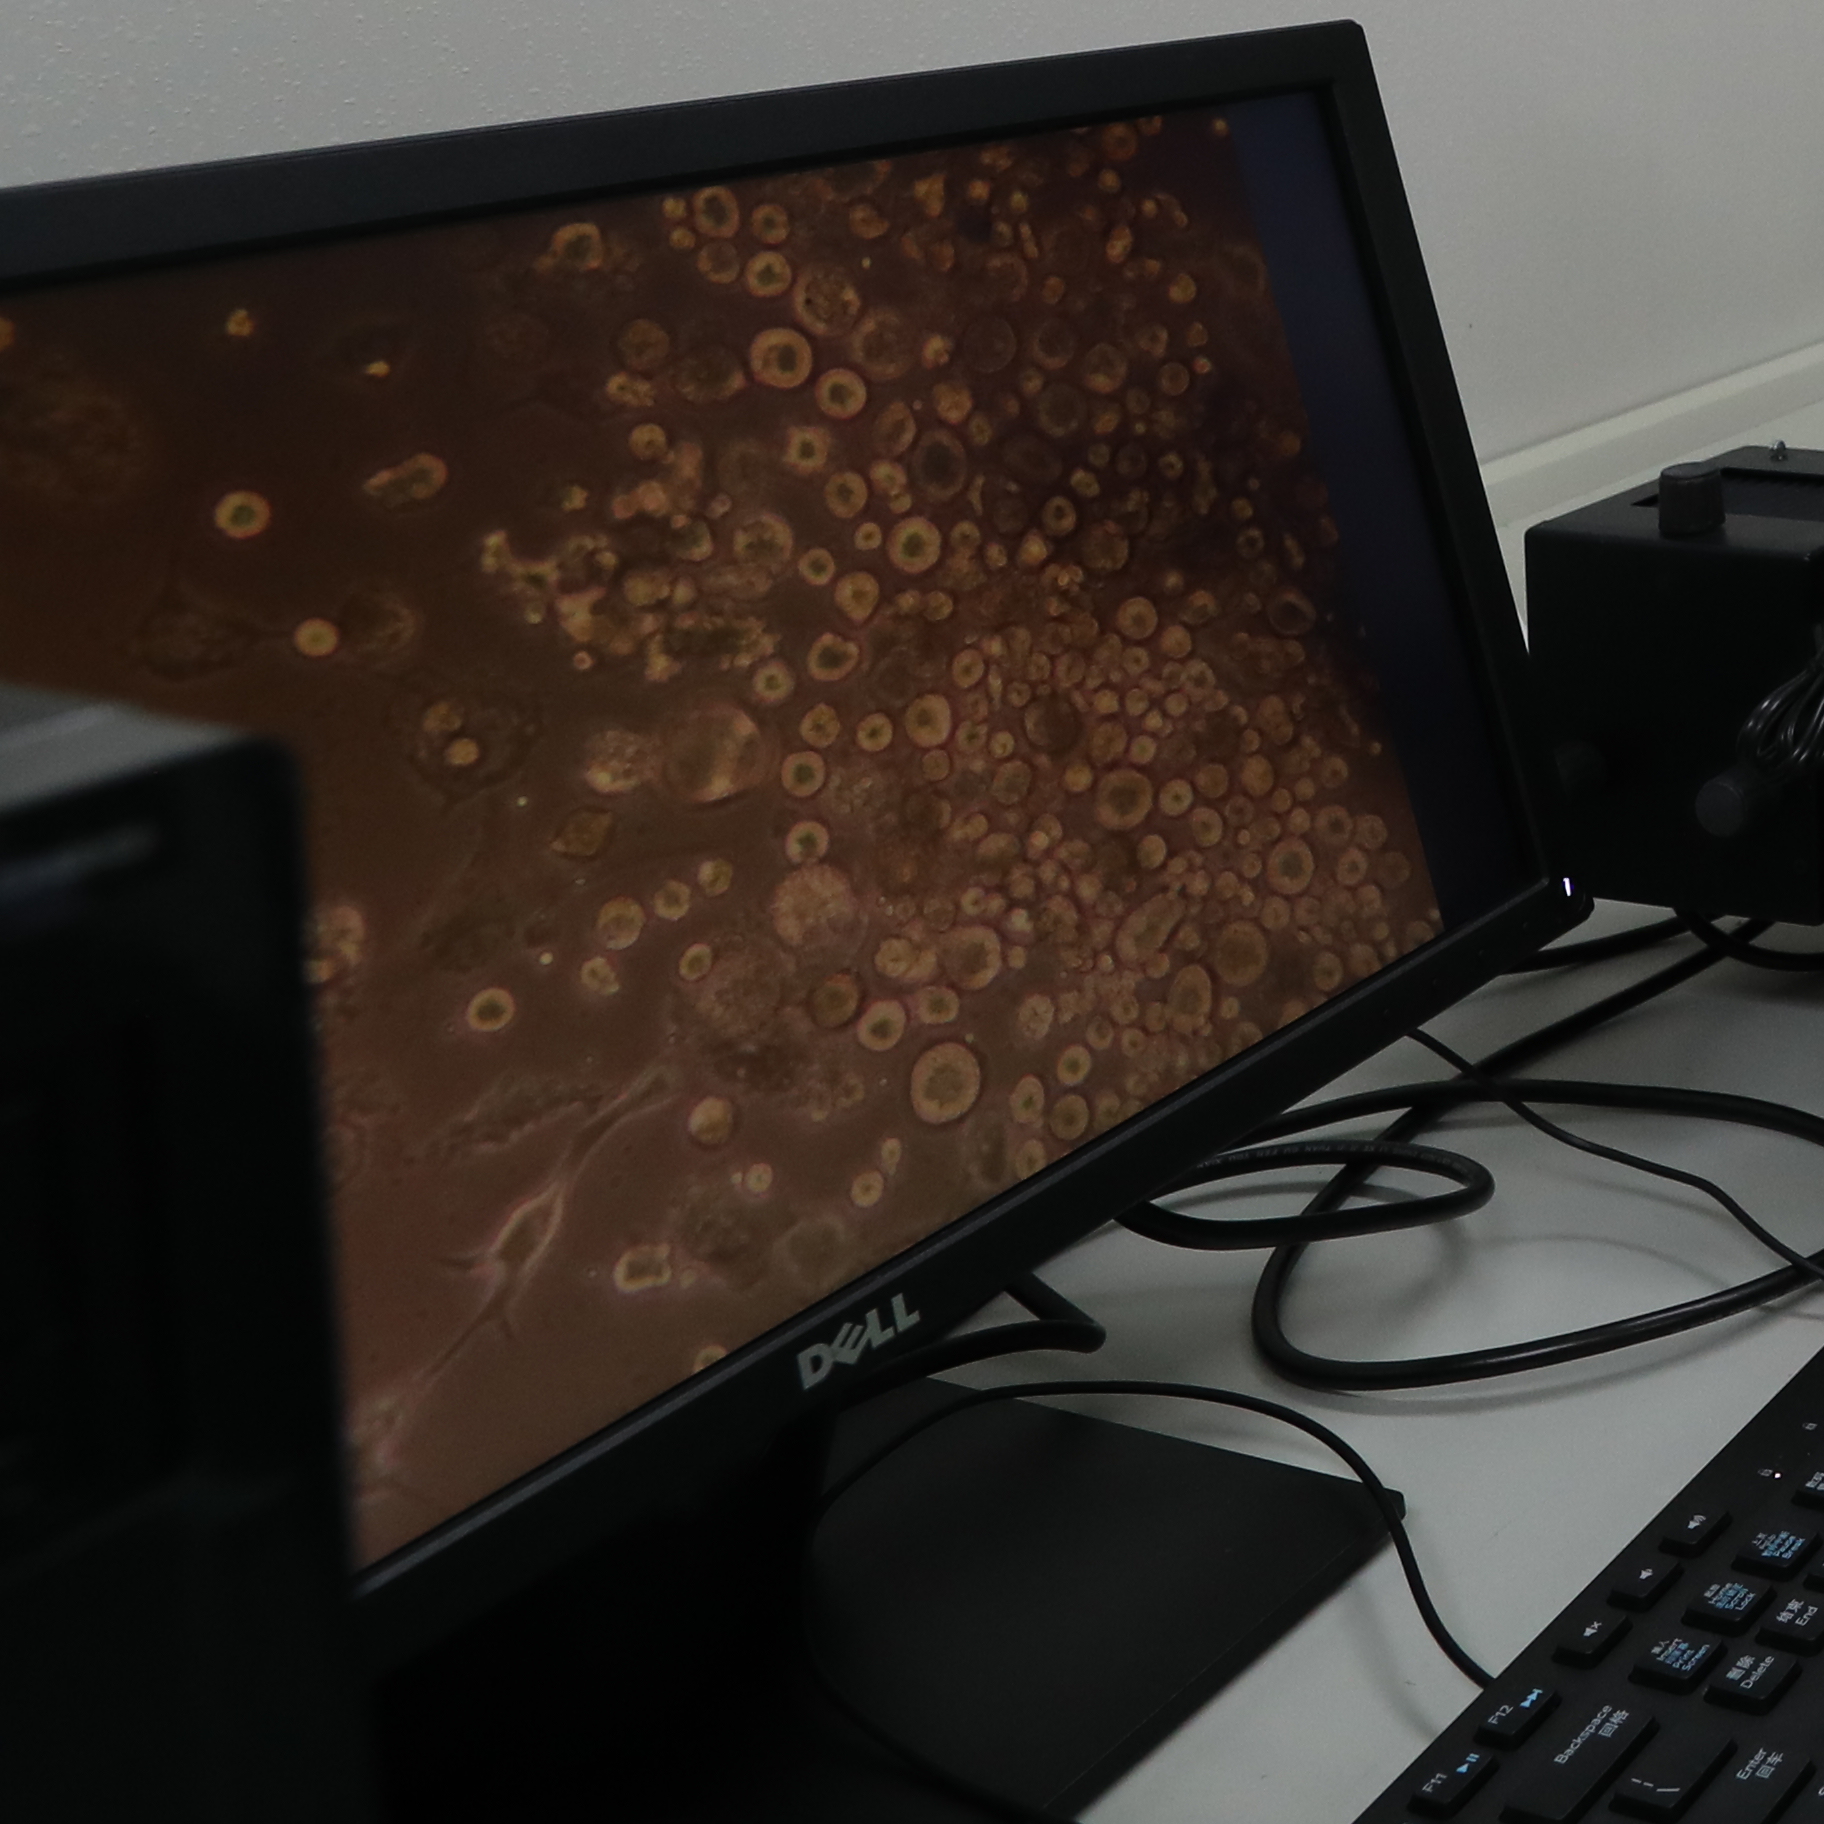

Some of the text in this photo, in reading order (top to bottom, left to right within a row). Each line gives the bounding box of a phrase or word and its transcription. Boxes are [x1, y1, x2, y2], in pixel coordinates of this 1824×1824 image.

[797, 1292, 921, 1390] DELL
[1735, 1592, 1756, 1611] Lock
[1776, 1598, 1805, 1624] 结束
[1795, 1605, 1819, 1627] End
[1682, 1643, 1711, 1672] Screen
[1725, 1654, 1756, 1681] 删除
[1740, 1655, 1775, 1690] Delete
[1487, 1704, 1514, 1726] F12
[1597, 1708, 1630, 1739] 回格
[1553, 1704, 1613, 1765] Backspace
[1735, 1747, 1767, 1781] Enter
[1754, 1751, 1784, 1779] 回车
[1421, 1773, 1448, 1793] F11
